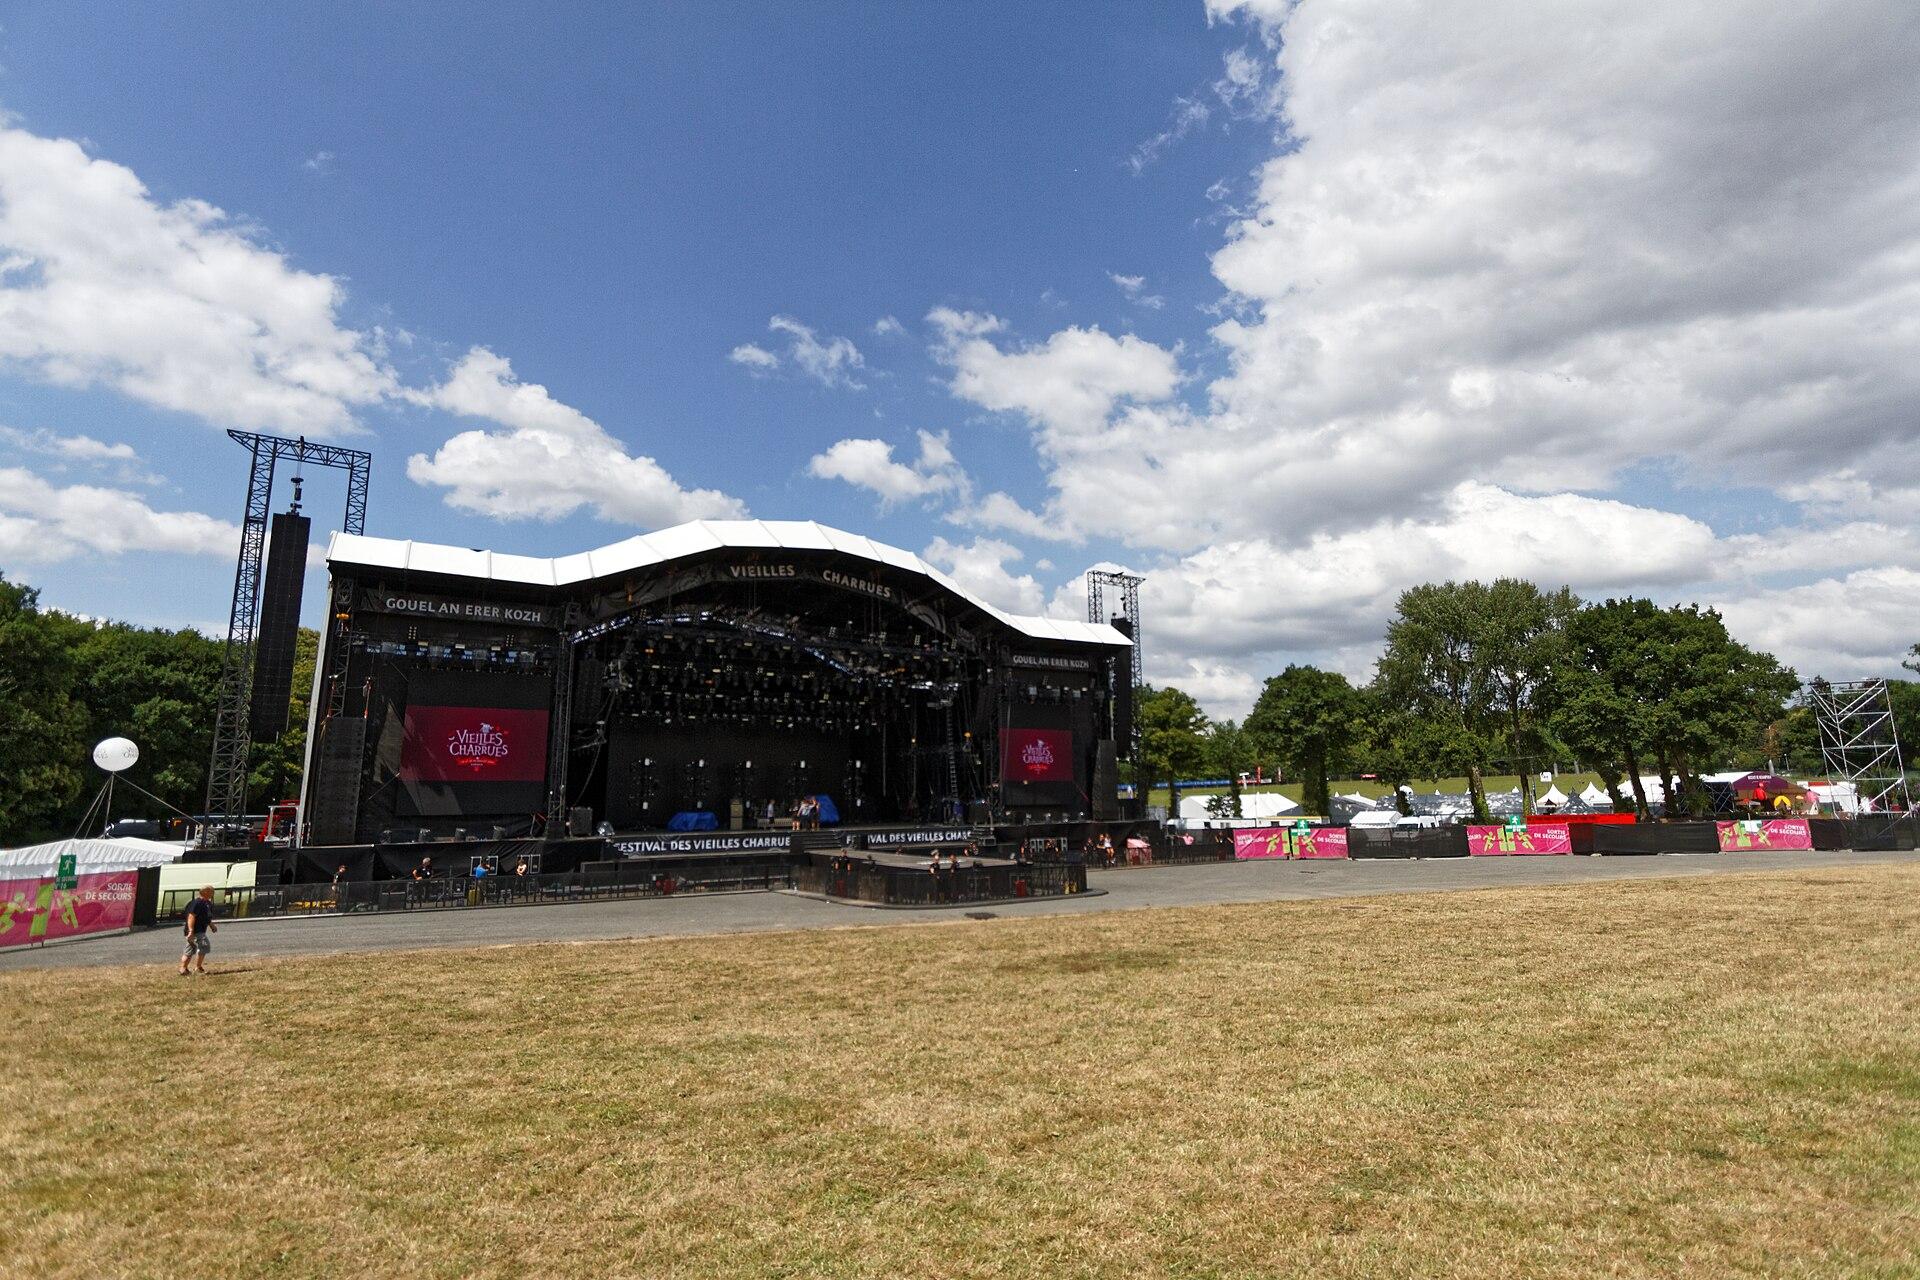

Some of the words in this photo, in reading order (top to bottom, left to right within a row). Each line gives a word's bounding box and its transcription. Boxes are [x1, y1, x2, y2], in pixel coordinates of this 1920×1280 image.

[730, 564, 796, 578] VIEILLES
[822, 569, 892, 599] CHARRUES
[386, 597, 435, 613] GOUEL
[438, 603, 460, 614] AN
[465, 604, 500, 618] ERER
[504, 608, 541, 623] KOZH
[1012, 655, 1038, 665] GOUEL
[456, 729, 503, 746] VIEILLES
[449, 742, 509, 758] CHARRUES
[670, 840, 692, 851] DES
[694, 838, 740, 850] VIEILLES
[742, 836, 791, 848] CHARRUE
[889, 832, 906, 843] DES
[907, 831, 944, 842] VIEILLES
[107, 883, 133, 891] SORTIE
[85, 892, 97, 900] DE
[98, 892, 133, 901] SECOURS
